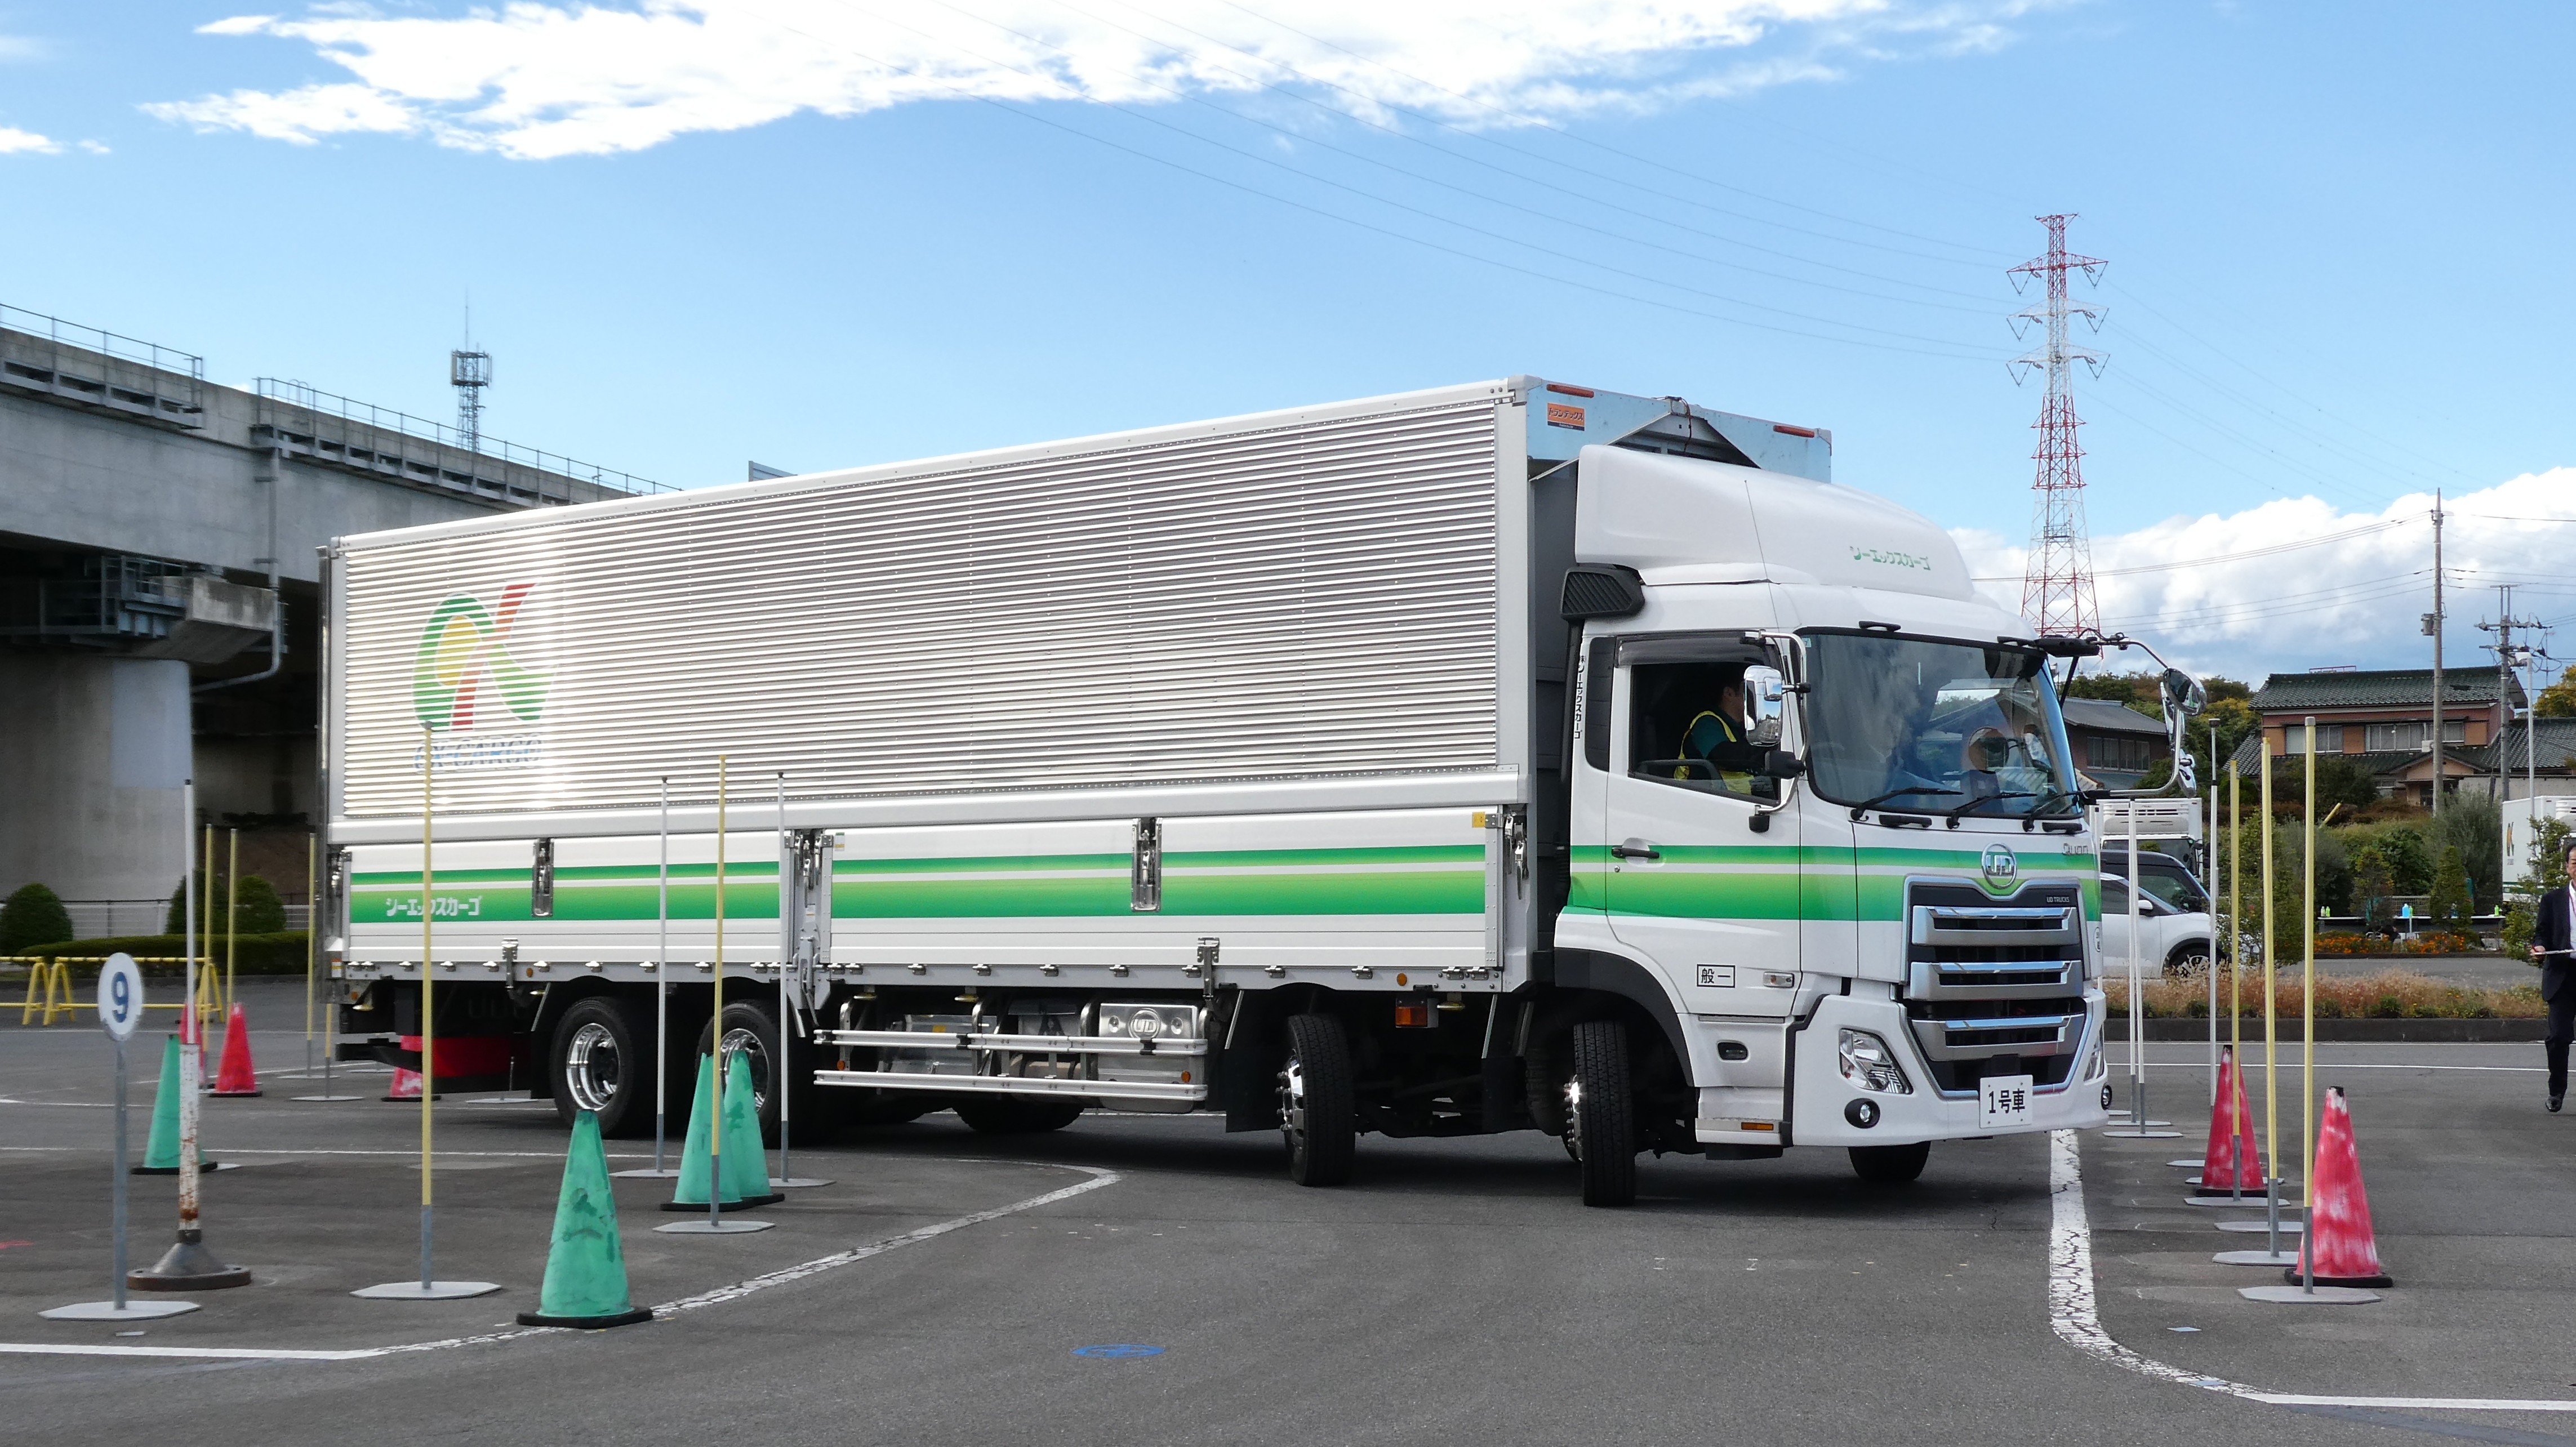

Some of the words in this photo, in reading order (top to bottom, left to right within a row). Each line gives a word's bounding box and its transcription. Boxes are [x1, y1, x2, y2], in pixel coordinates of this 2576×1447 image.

[1549, 407, 1583, 421] トランテックス
[1849, 546, 1930, 570] シーエックスカーゴ
[1985, 855, 2014, 875] UD
[112, 972, 128, 1023] 9
[1133, 1019, 1156, 1032] UD
[1989, 1088, 2025, 1114] 1号車
